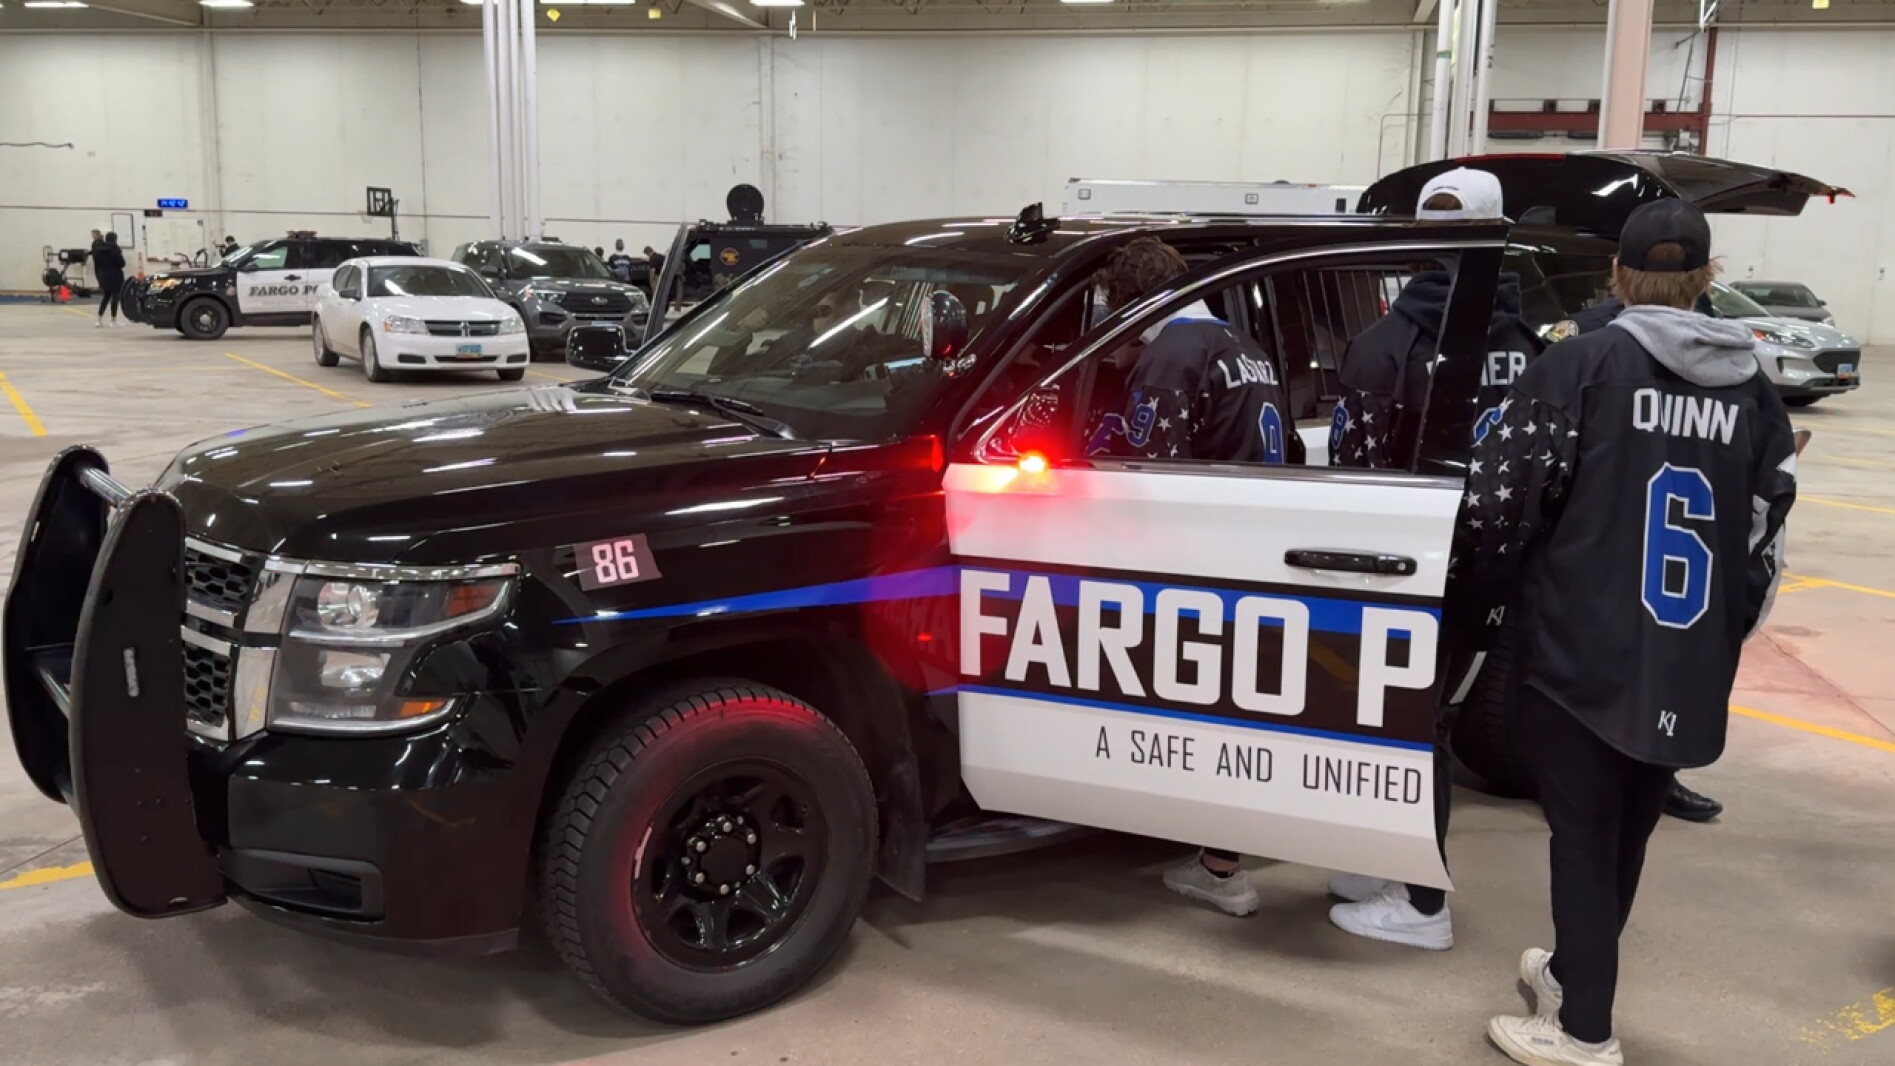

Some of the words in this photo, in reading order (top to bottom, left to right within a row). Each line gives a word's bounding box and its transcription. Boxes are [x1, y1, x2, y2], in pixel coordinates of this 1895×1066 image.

[249, 285, 299, 297] FARGO
[1125, 402, 1157, 448] 9
[1633, 388, 1739, 445] QUINN
[592, 540, 639, 583] 86
[1641, 462, 1715, 629] 6
[960, 569, 1310, 716] FARGO
[1356, 606, 1438, 728] P
[1095, 726, 1110, 759] A
[1130, 730, 1195, 772] SAFE
[1216, 746, 1273, 782] AND
[1303, 754, 1422, 805] UNIFIED
